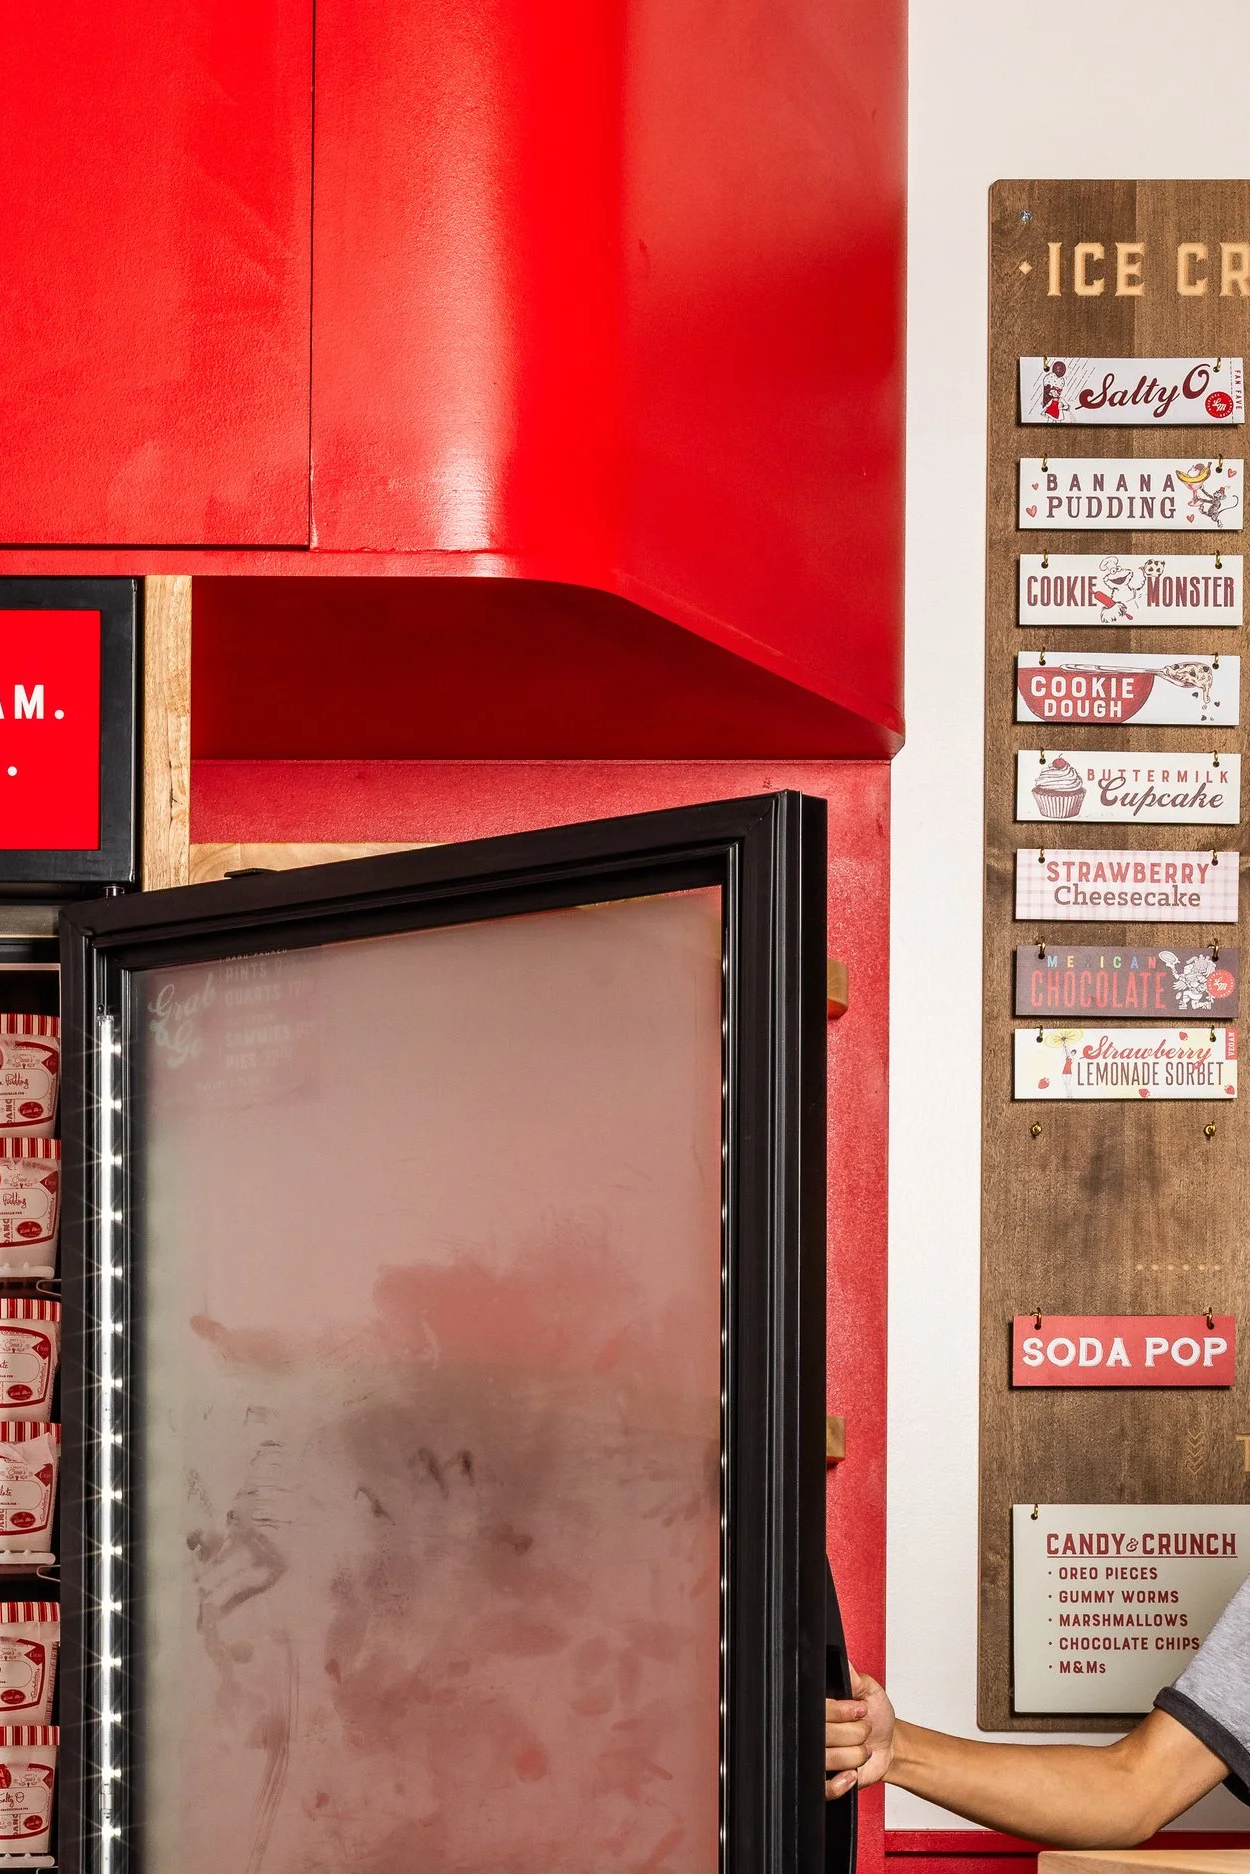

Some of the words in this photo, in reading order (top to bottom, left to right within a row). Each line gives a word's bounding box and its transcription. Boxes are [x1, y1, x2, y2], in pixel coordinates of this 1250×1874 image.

[1047, 242, 1146, 297] ICE
[1234, 370, 1242, 385] FAN
[1075, 373, 1180, 418] Salty
[1182, 363, 1211, 400] O
[1235, 390, 1243, 410] FAVE
[1046, 473, 1175, 492] BANANA
[1046, 496, 1176, 519] PUDDING
[1027, 575, 1098, 607] COOKIE
[1146, 576, 1235, 607] MONSTER
[1031, 676, 1135, 698] COOKIE
[1044, 699, 1123, 718] DOUGH
[1087, 768, 1229, 784] BUTTERMILK
[1098, 776, 1224, 816] Cupcake
[1046, 861, 1209, 884] STRAWBERRY
[1054, 884, 1201, 907] Cheesecake
[1047, 955, 1157, 969] MEXICAN
[1030, 969, 1167, 1009] CHOCOLATE
[1079, 1036, 1212, 1070] Strawberry
[1228, 1031, 1236, 1056] VEGAN
[1077, 1061, 1159, 1086] LEMONADE
[1165, 1061, 1224, 1086] SORBET
[1022, 1337, 1132, 1367] SODA
[1145, 1337, 1228, 1367] POP
[1047, 1533, 1125, 1555] CANDY
[1126, 1537, 1139, 1552] &
[1142, 1533, 1236, 1555] CRUNCH
[1059, 1567, 1098, 1580] OREO
[1105, 1567, 1158, 1580] PIECES
[1059, 1590, 1115, 1603] GUMMY
[1121, 1590, 1179, 1603] WORMS
[1059, 1614, 1188, 1627] MARSHMALLOWS
[1059, 1637, 1148, 1650] CHOCOLATE
[1155, 1637, 1200, 1650] CHIPS
[1059, 1661, 1106, 1674] M&Ms
